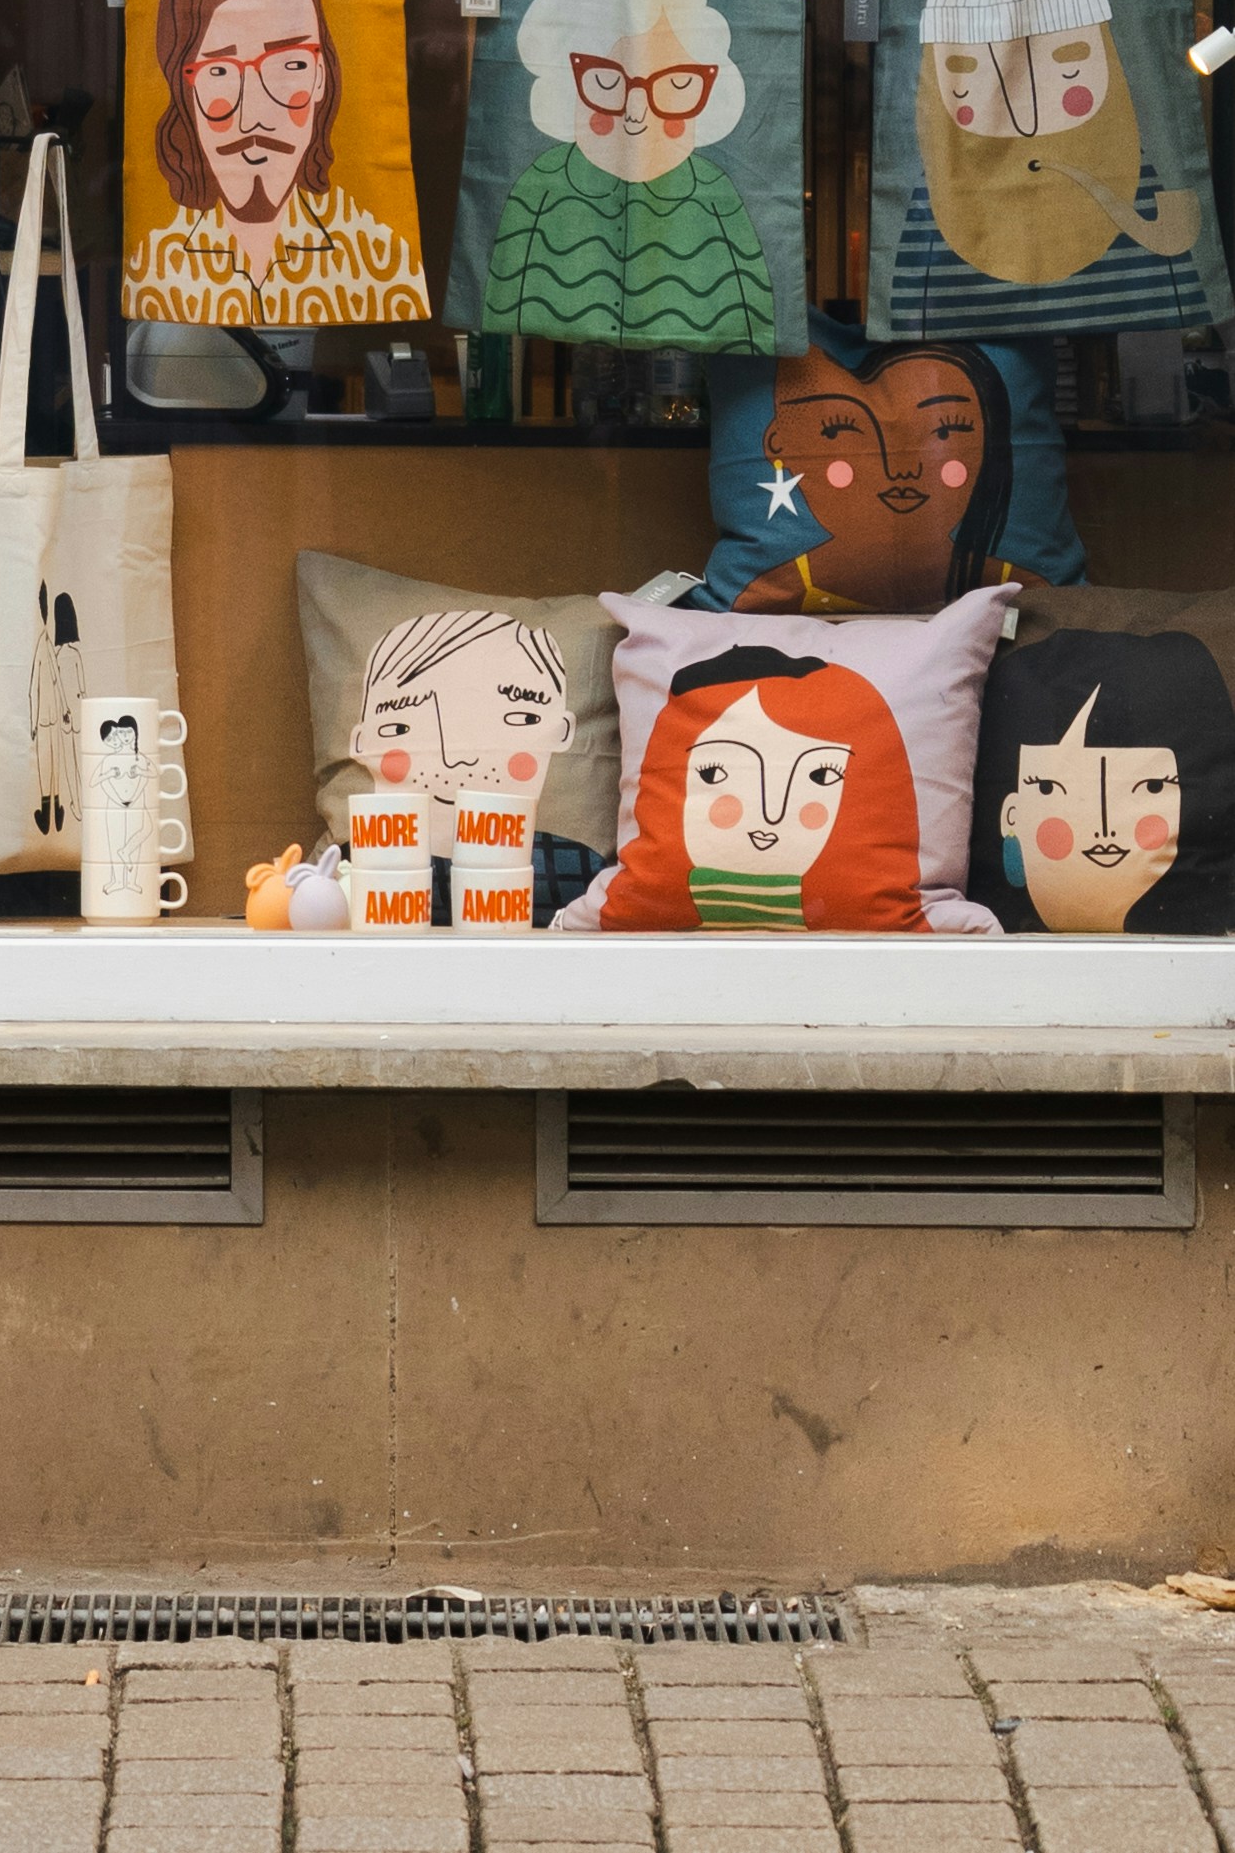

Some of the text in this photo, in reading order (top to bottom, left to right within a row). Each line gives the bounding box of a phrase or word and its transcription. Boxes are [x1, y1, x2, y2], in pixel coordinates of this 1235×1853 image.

[352, 810, 526, 848] AMORE AMORE
[365, 887, 531, 925] AMORE AMORE
